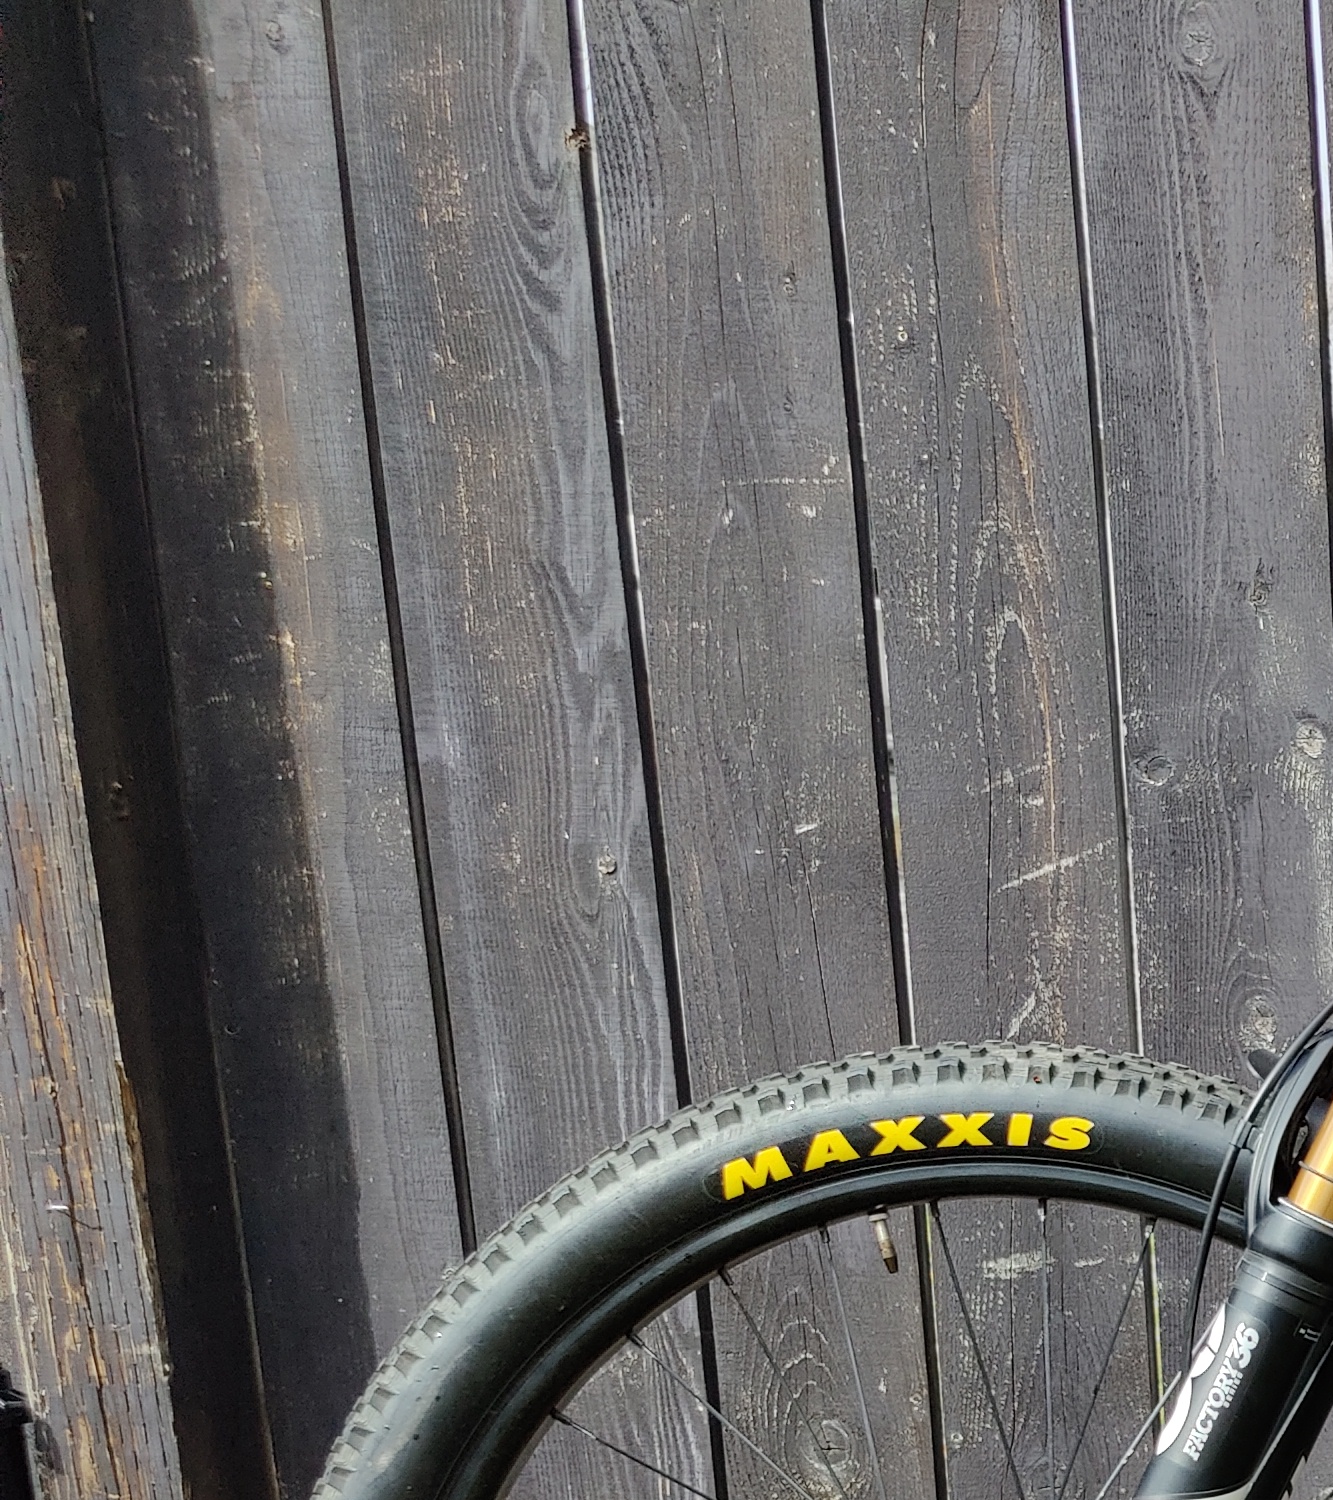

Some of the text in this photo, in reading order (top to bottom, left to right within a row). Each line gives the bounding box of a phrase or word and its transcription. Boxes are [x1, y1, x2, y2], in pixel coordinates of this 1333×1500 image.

[722, 1112, 1095, 1200] MAXXIS
[1182, 1322, 1260, 1461] FACTORY 36
